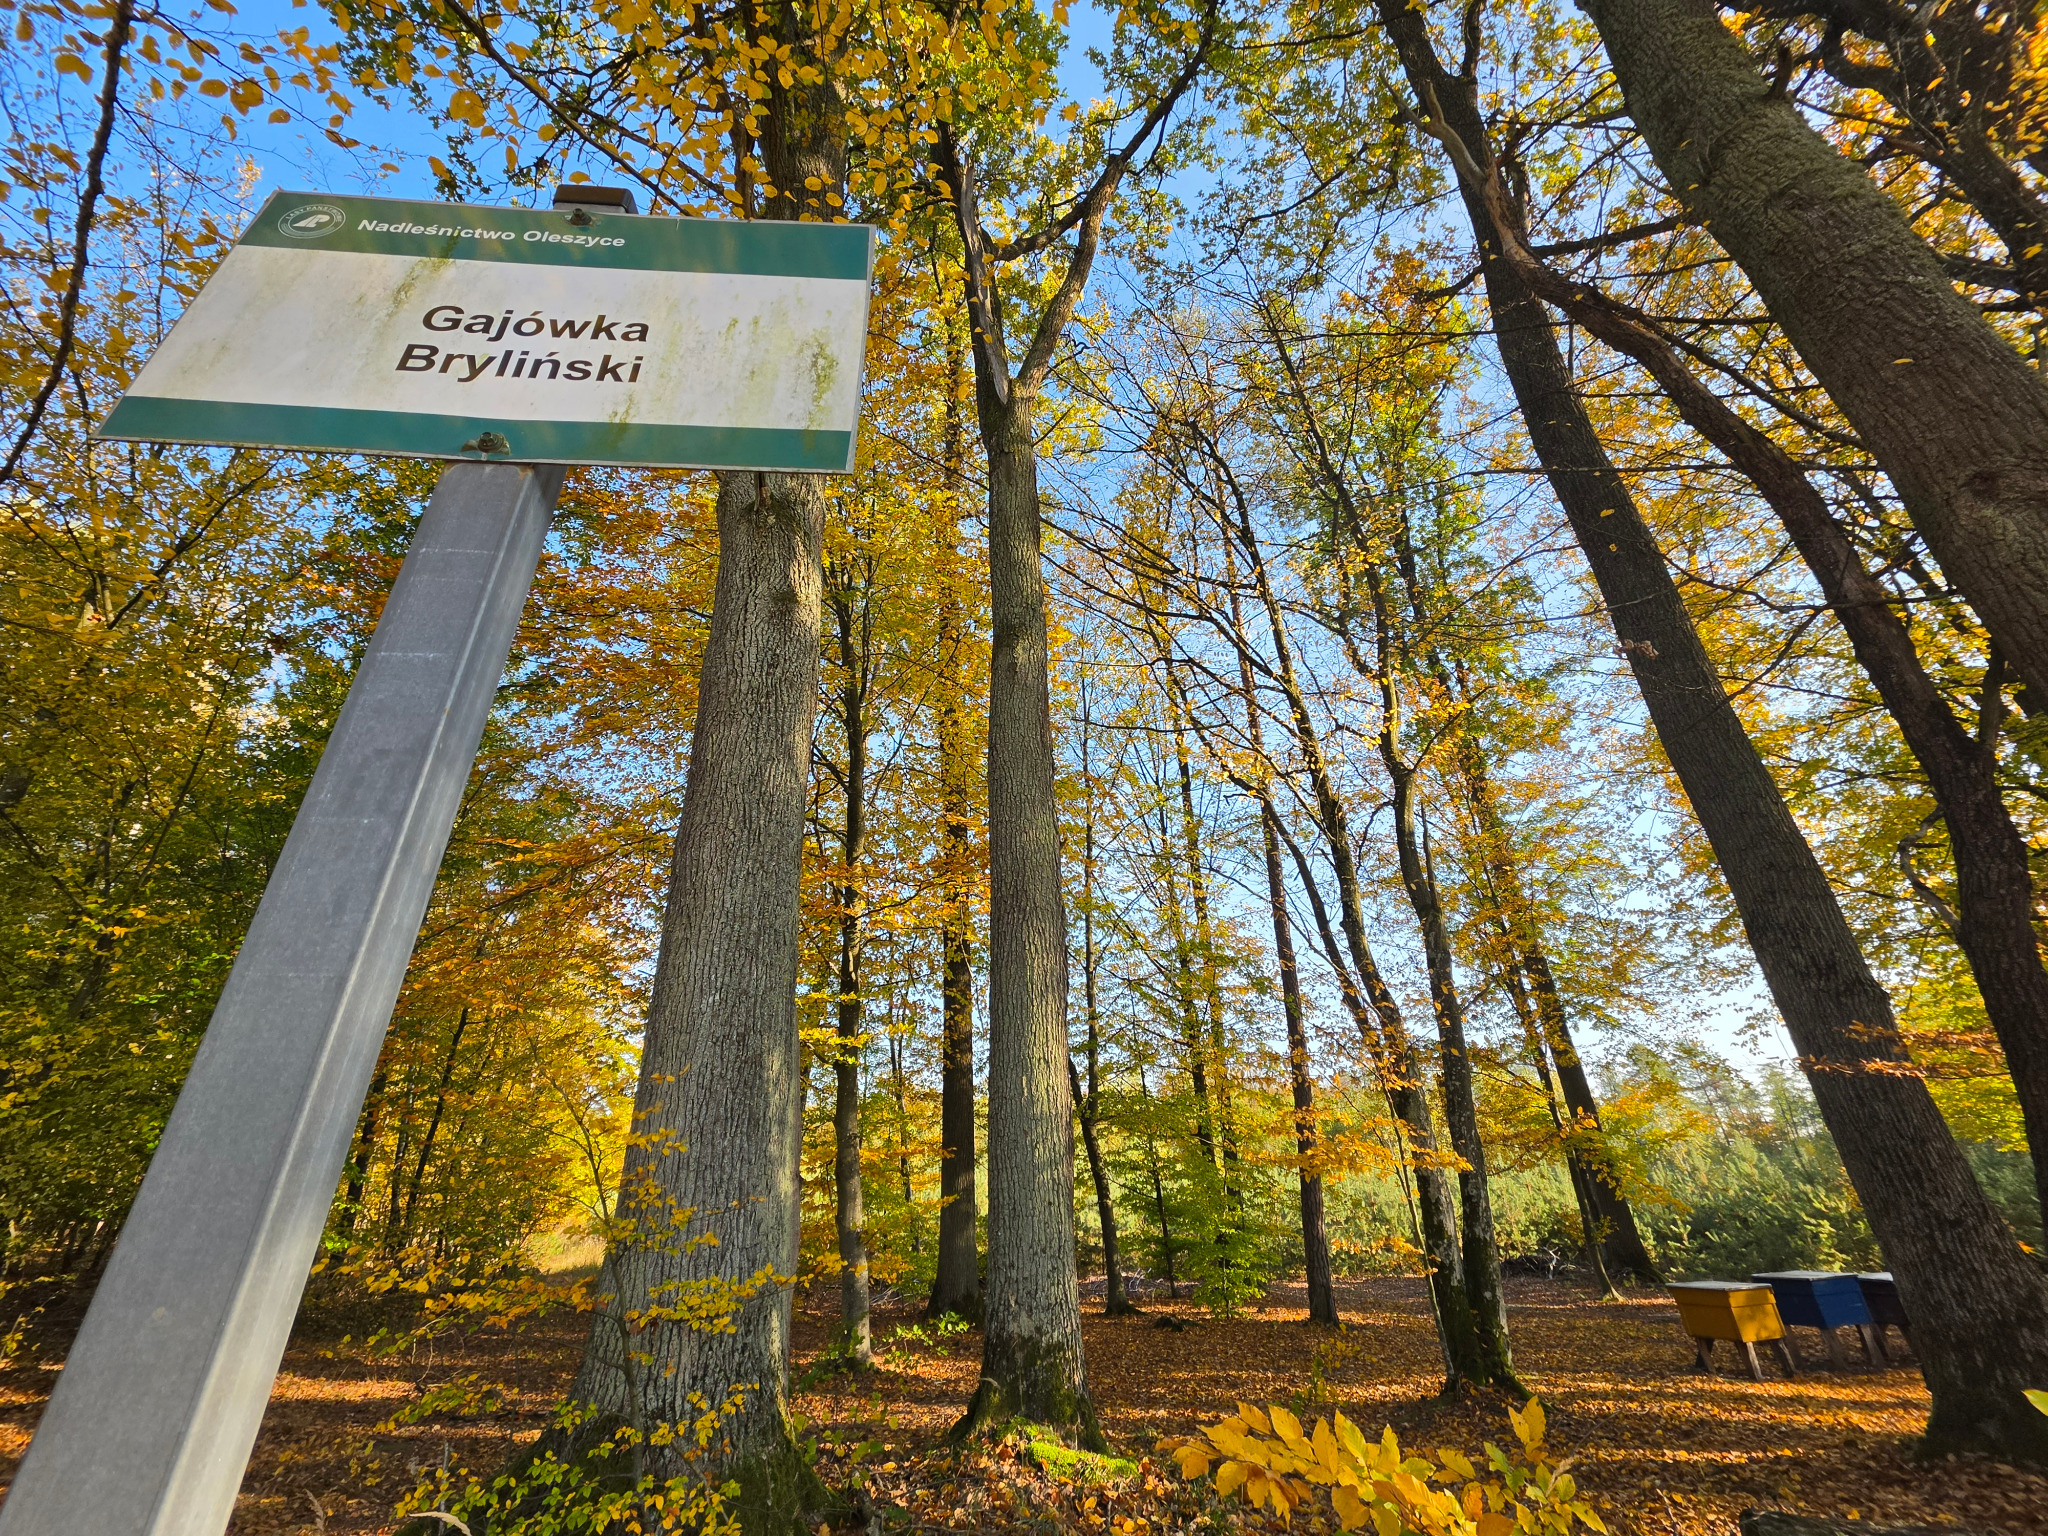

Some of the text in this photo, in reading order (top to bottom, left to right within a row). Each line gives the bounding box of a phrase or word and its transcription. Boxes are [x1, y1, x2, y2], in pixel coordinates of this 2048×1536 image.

[358, 219, 626, 248] Nadleśnictwo Oleszyce
[422, 304, 650, 343] Gajówka
[395, 343, 644, 383] Bryliński
